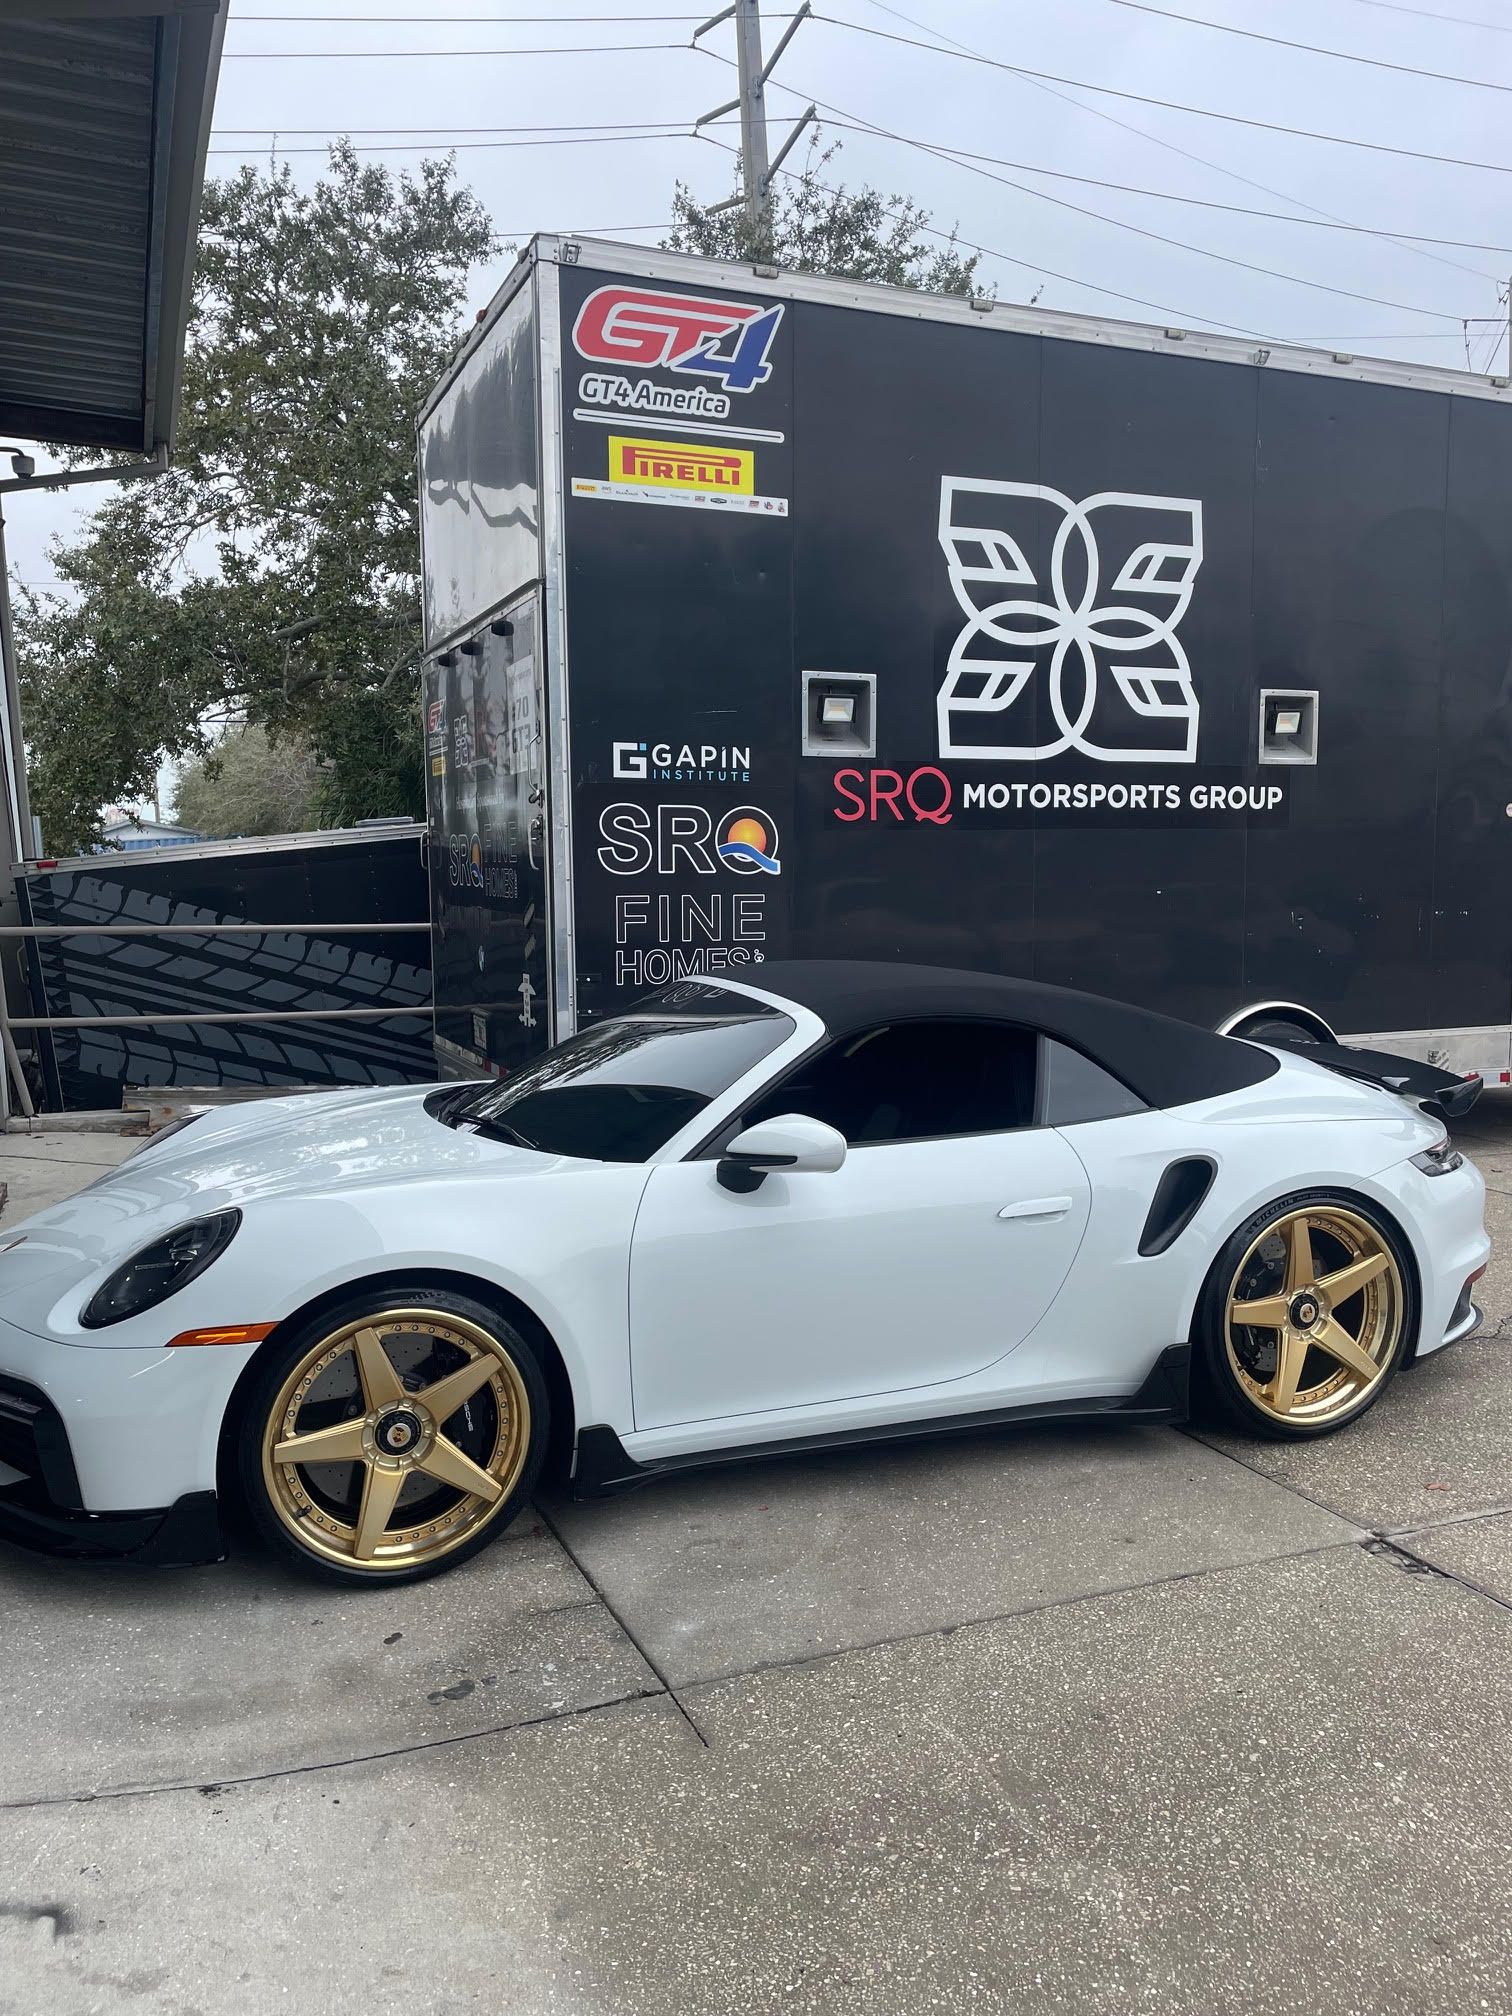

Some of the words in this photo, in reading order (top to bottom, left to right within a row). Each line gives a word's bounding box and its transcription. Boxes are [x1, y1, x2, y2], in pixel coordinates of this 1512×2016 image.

[572, 284, 785, 393] GT4
[581, 375, 632, 404] GT4
[634, 381, 729, 416] America
[622, 446, 742, 486] PIRELLI
[653, 770, 750, 782] INSTITUTE
[832, 766, 953, 825] SRQ
[963, 783, 1181, 809] MOTORSPORTS
[1189, 785, 1284, 810] GROUP
[449, 833, 484, 888] SRQ
[598, 802, 781, 876] SRQ
[615, 894, 766, 944] FINE
